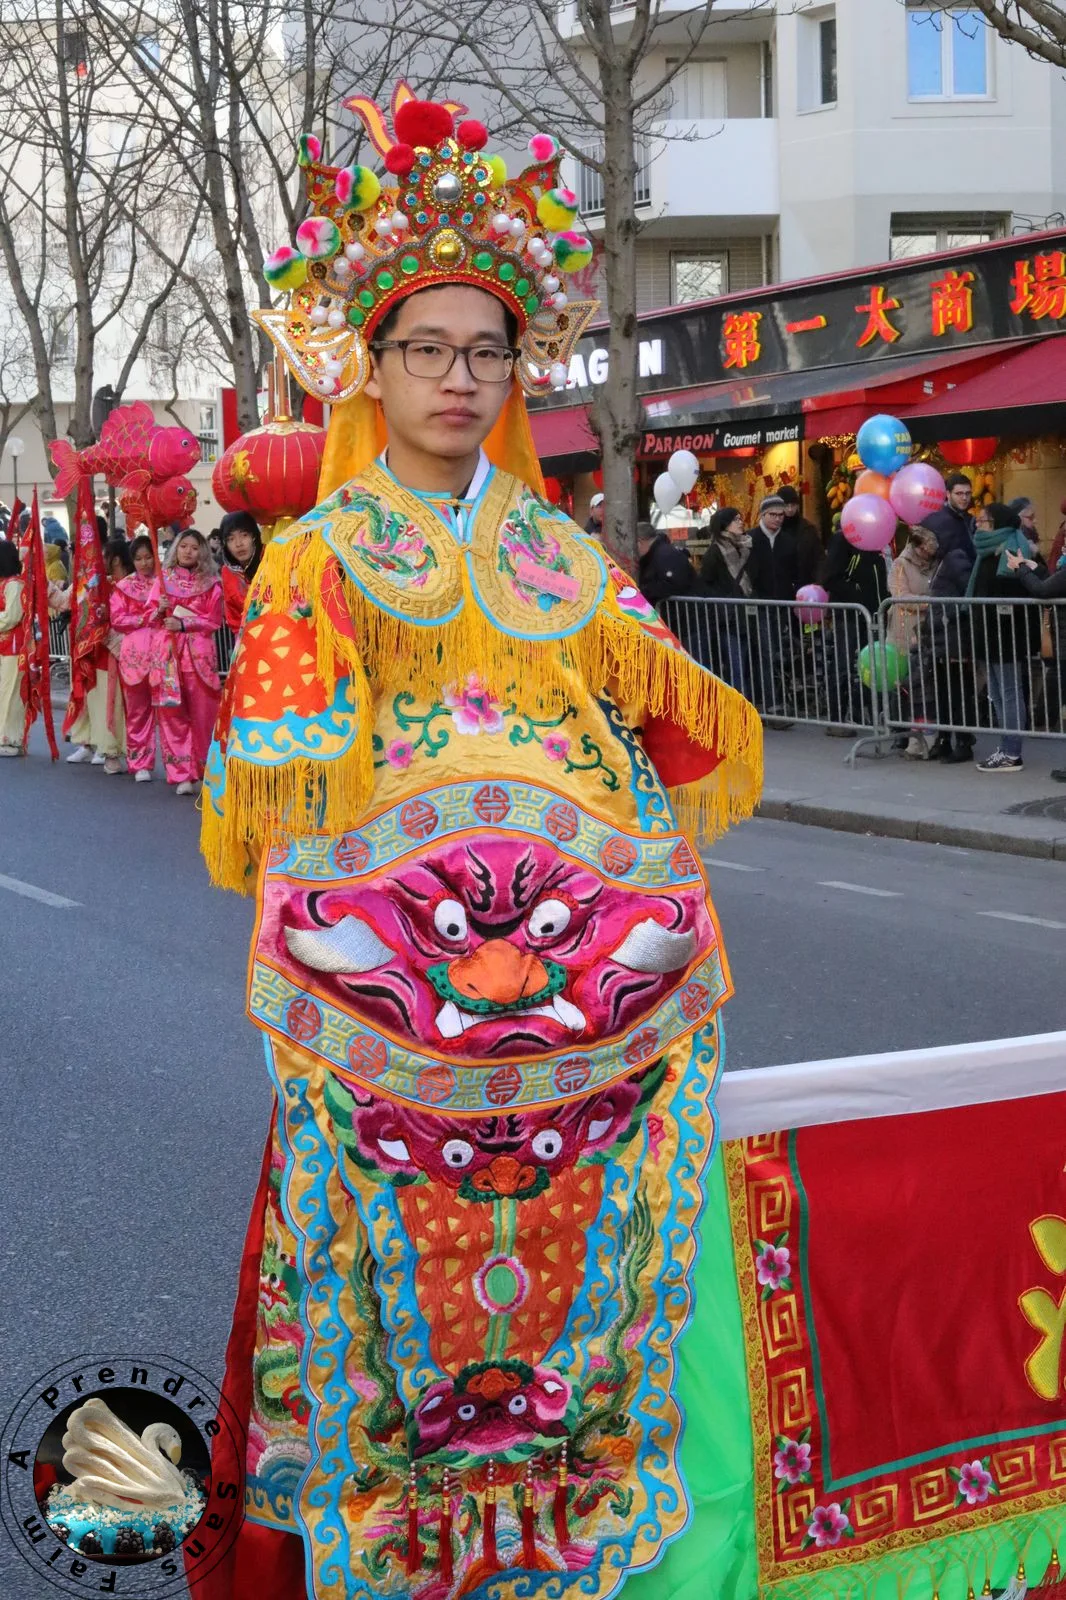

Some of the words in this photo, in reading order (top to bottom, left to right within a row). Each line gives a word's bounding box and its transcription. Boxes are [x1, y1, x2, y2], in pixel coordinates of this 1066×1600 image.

[723, 250, 1066, 369] 第一大商場
[644, 432, 715, 453] PARAGON
[723, 430, 762, 448] Gourmet
[765, 425, 799, 443] market
